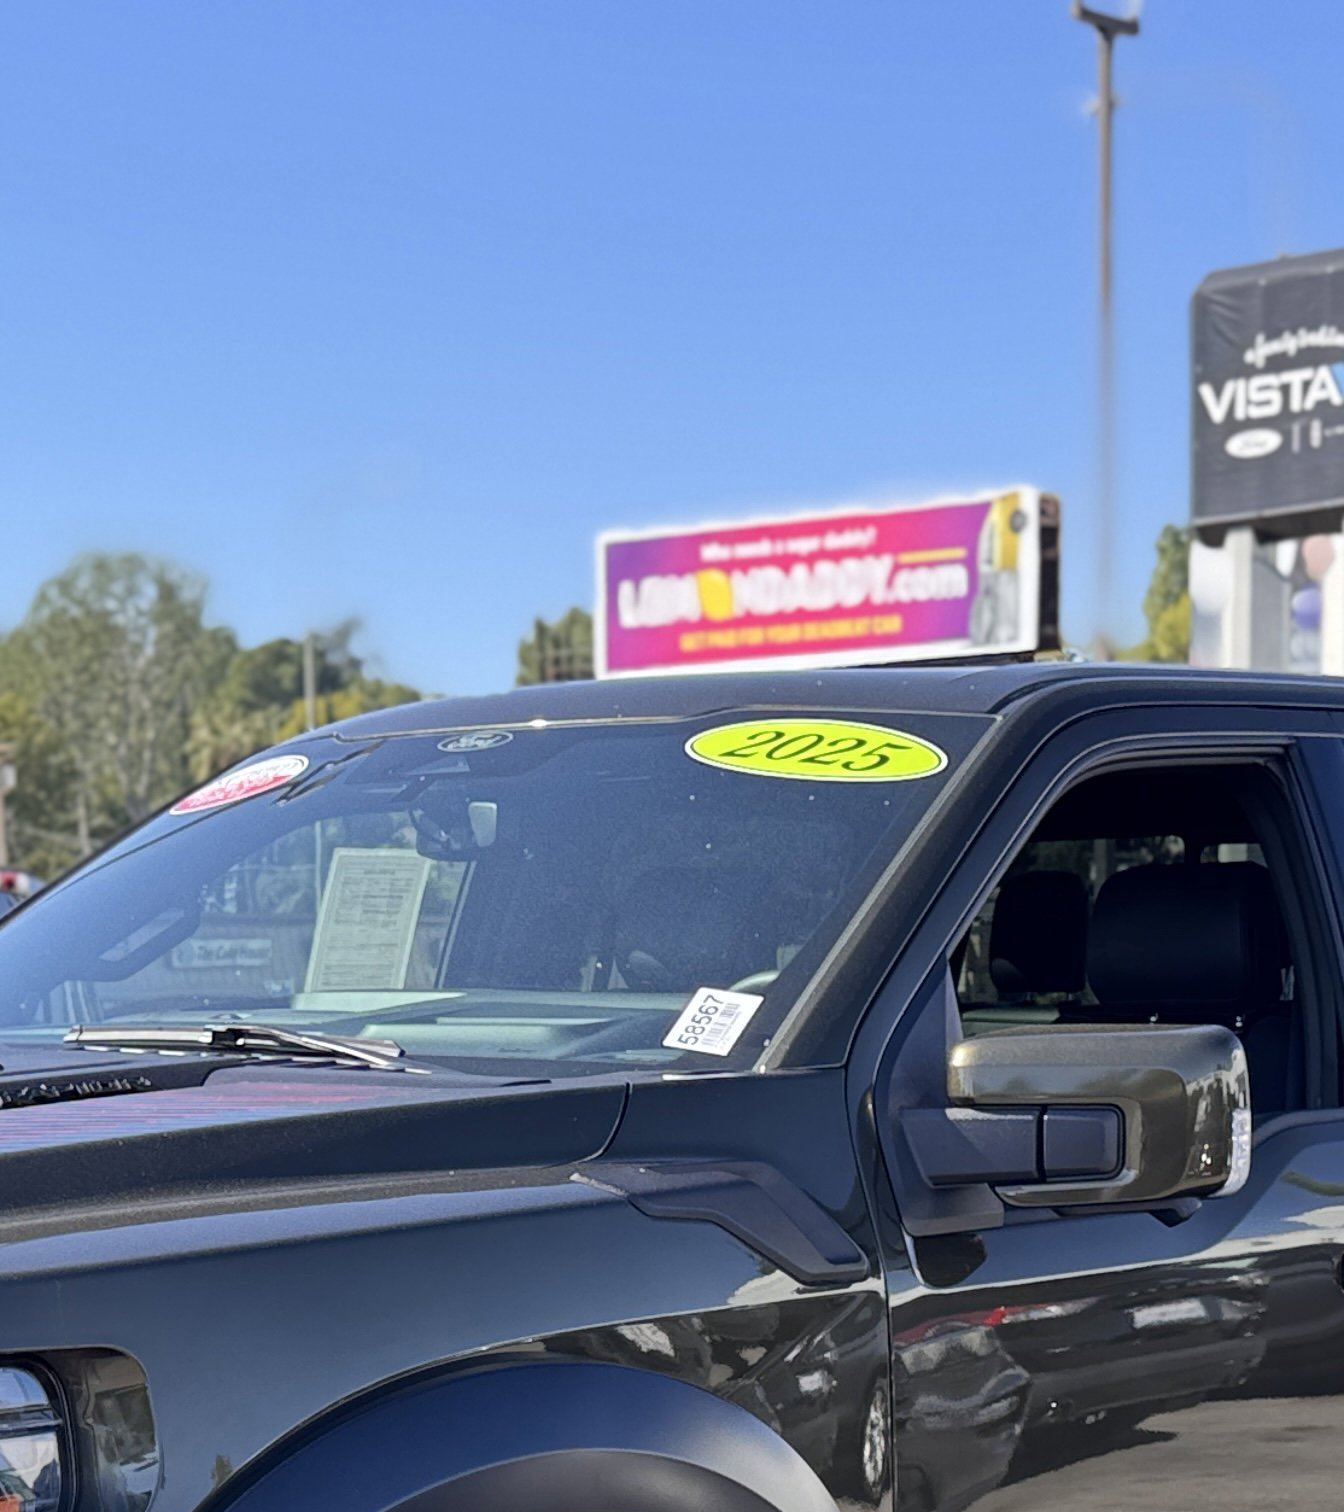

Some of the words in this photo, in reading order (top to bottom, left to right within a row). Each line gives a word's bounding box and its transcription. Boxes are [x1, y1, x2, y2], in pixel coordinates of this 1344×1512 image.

[1198, 364, 1343, 424] VISTA
[718, 730, 913, 771] 2025
[677, 994, 724, 1046] 58567
